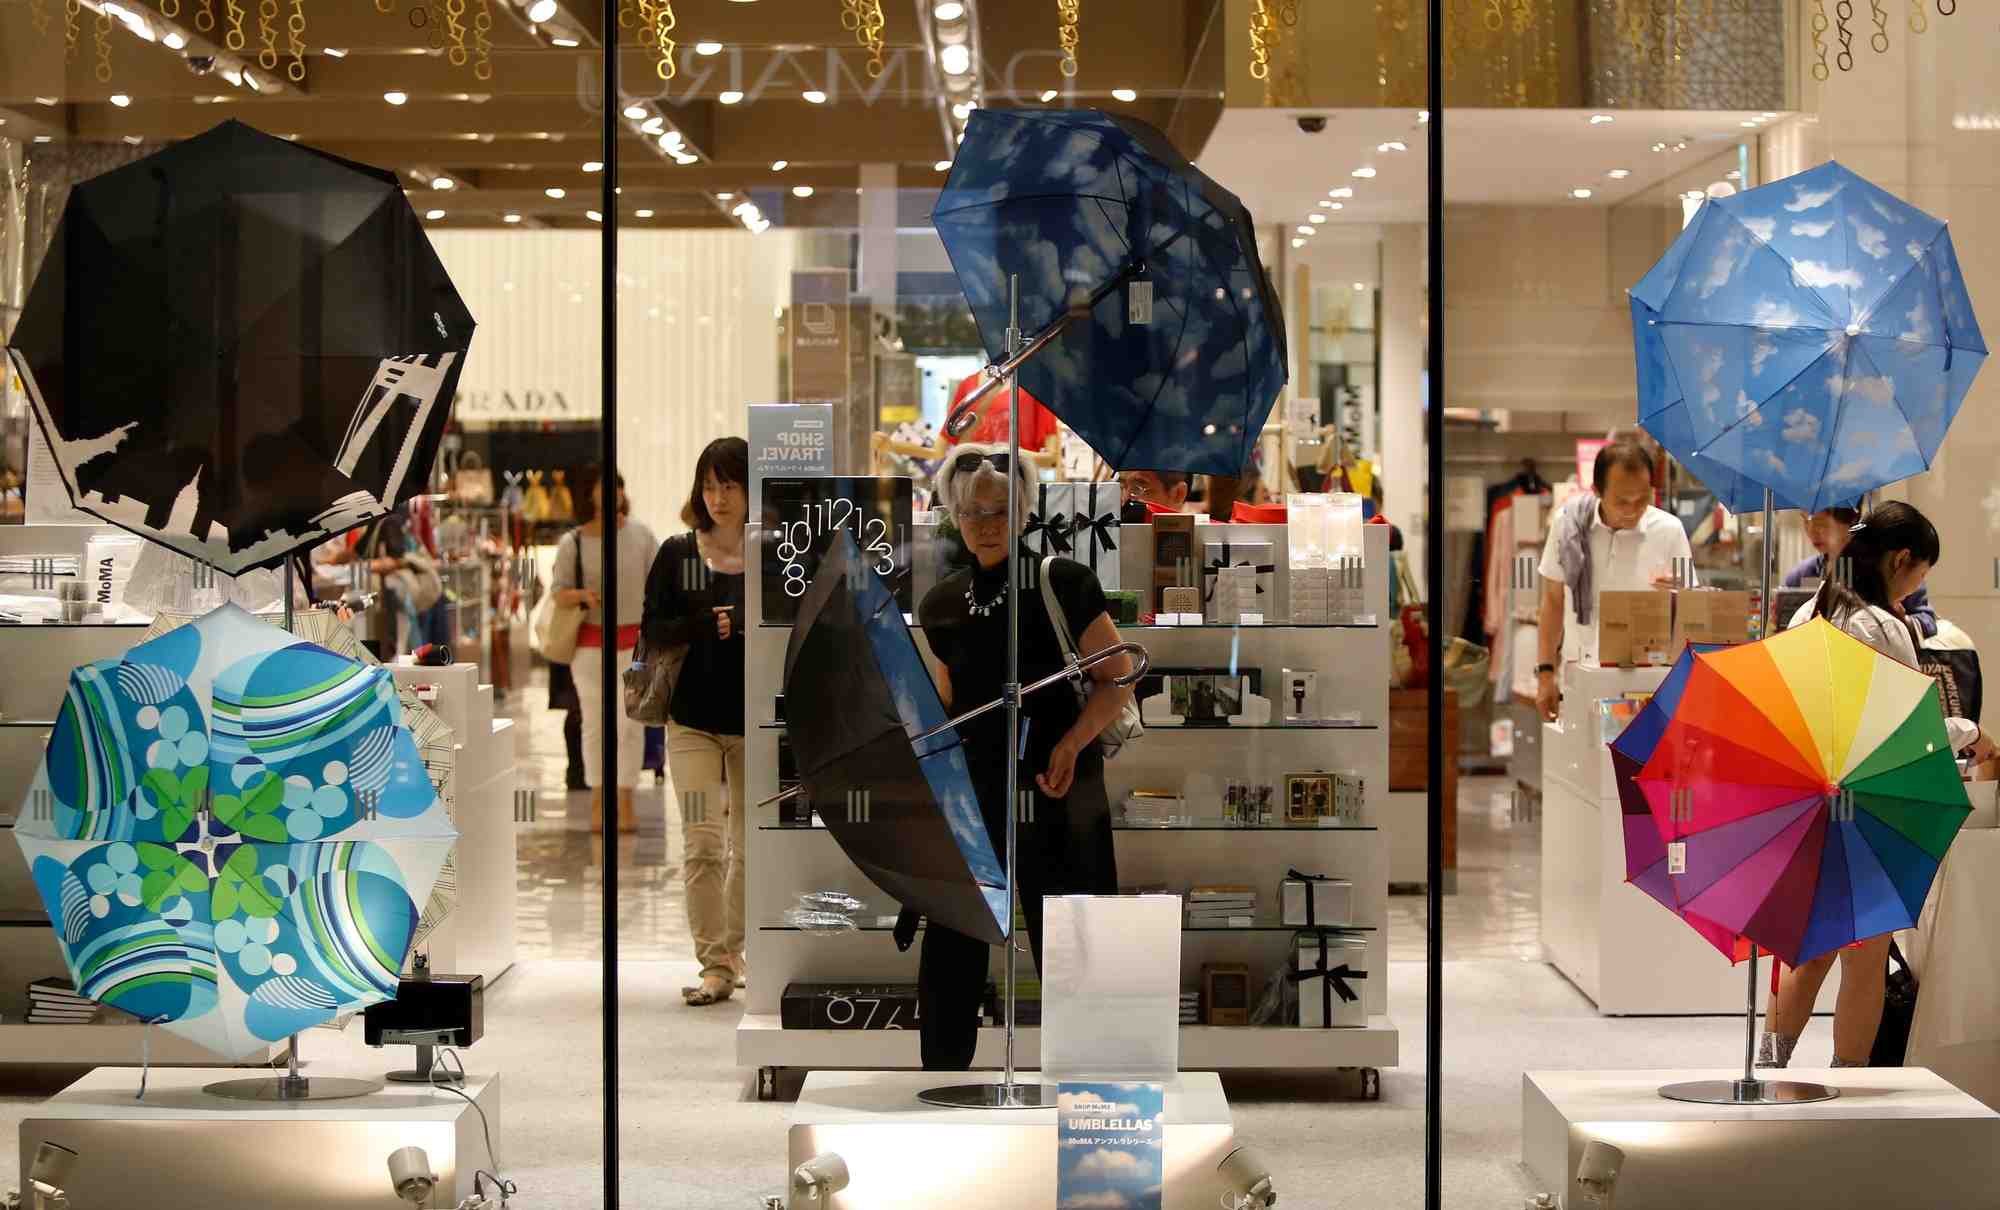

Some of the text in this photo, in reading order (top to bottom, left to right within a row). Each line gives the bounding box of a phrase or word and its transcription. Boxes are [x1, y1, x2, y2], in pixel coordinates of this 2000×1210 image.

[803, 504, 822, 537] 11
[824, 498, 853, 531] 12
[855, 507, 862, 540] 1
[781, 520, 812, 554] 10
[864, 518, 887, 551] 2
[777, 542, 797, 575] 9
[874, 542, 895, 575] 3
[97, 557, 114, 604] MoMA
[784, 563, 806, 597] 8
